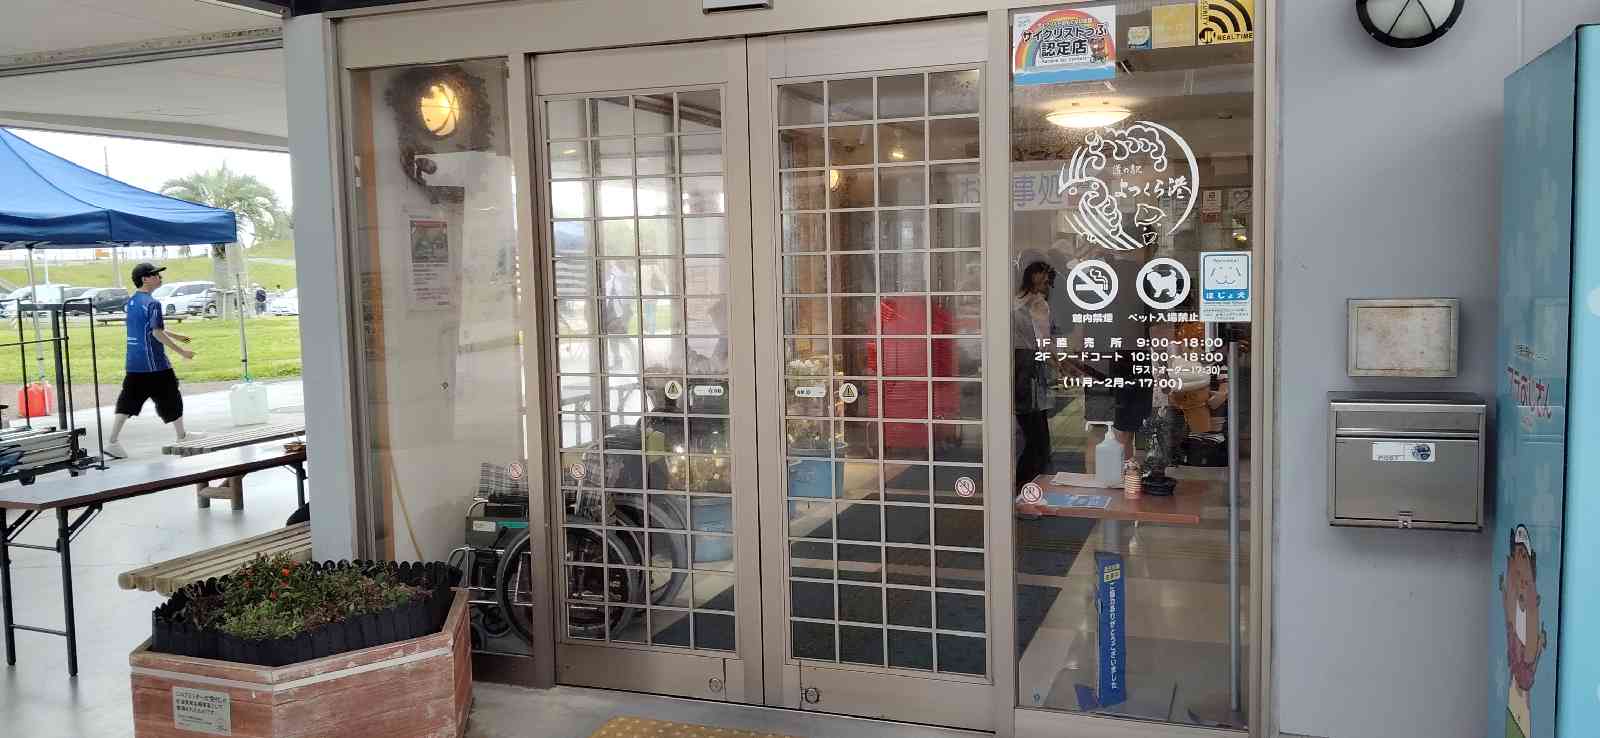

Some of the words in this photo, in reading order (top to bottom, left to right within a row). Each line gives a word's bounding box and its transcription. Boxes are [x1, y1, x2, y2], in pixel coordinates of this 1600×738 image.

[1041, 40, 1088, 57] 認定店
[1128, 313, 1199, 322] ペット入場禁止
[1036, 338, 1051, 348] 1F
[1034, 352, 1051, 361] 2F
[1058, 352, 1123, 361] フードコート
